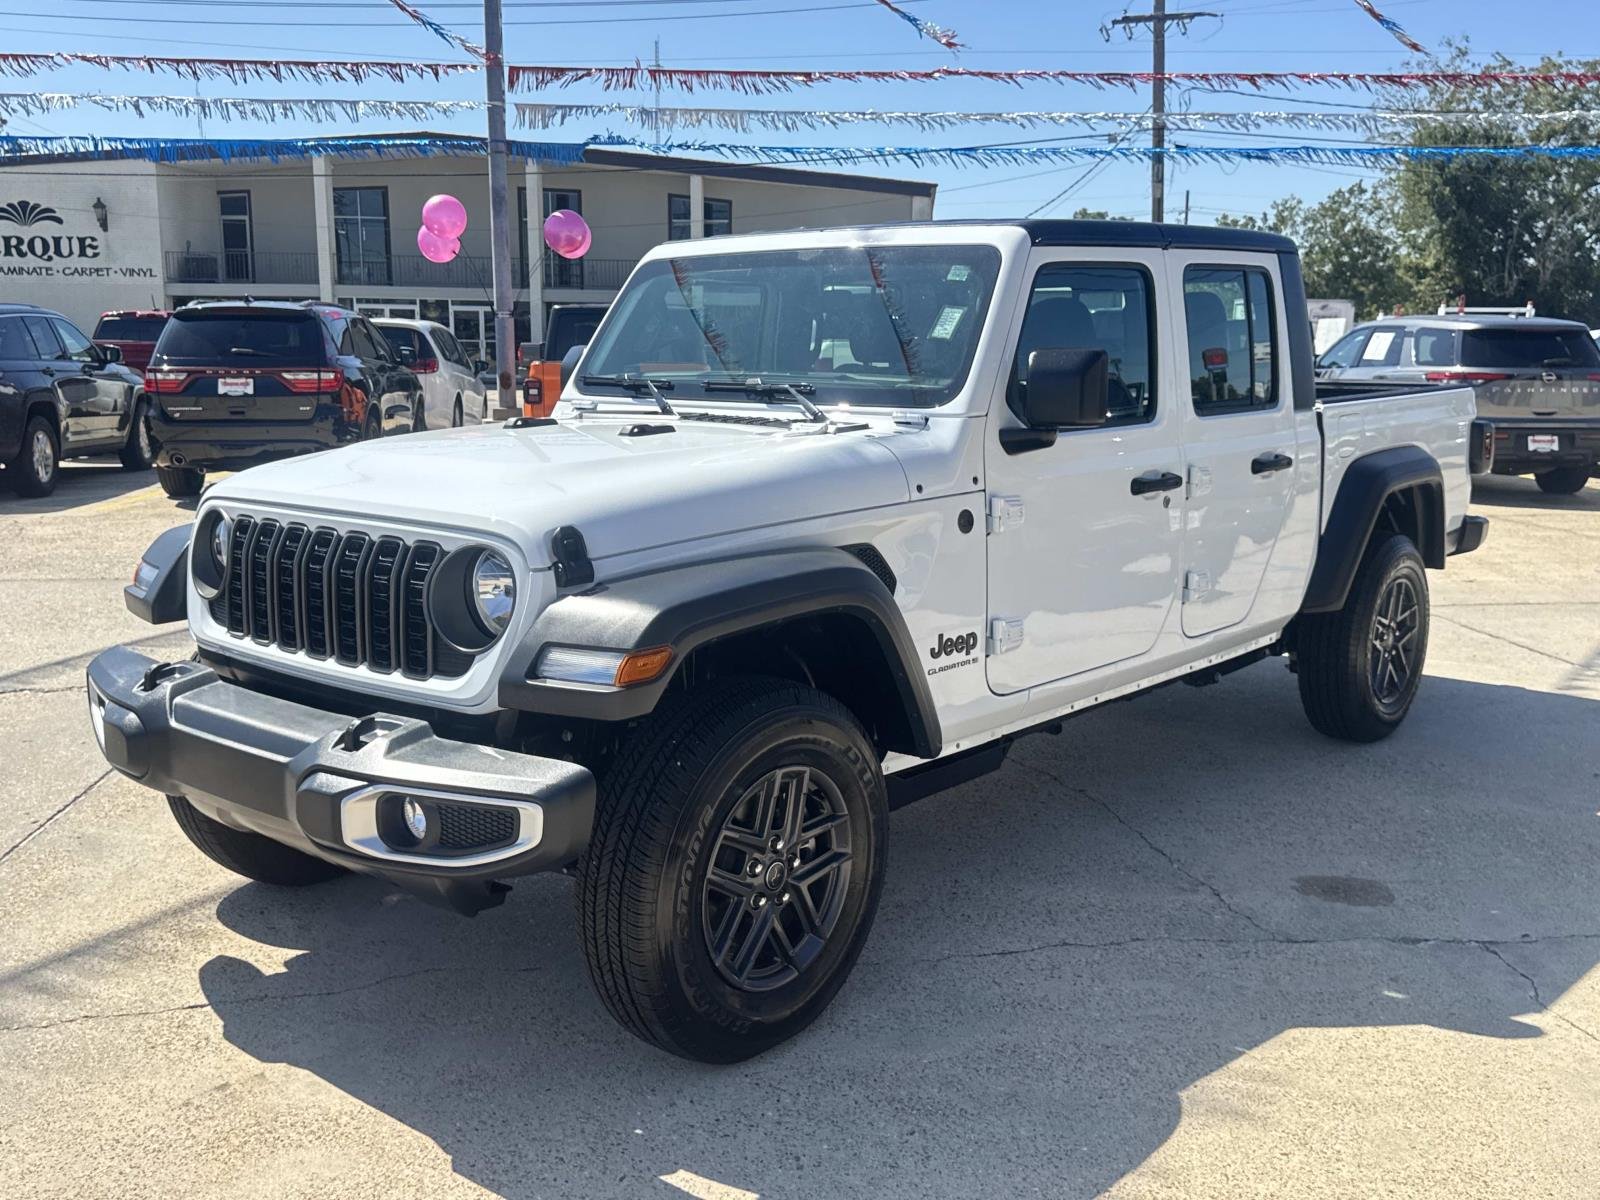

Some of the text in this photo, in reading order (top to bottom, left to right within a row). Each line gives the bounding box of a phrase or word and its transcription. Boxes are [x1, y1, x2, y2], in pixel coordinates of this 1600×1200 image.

[0, 235, 100, 262] RQUE
[62, 267, 112, 277] CARPET
[119, 267, 157, 277] VINYL
[930, 631, 978, 660] Jeep
[927, 659, 971, 676] GLADIATOR
